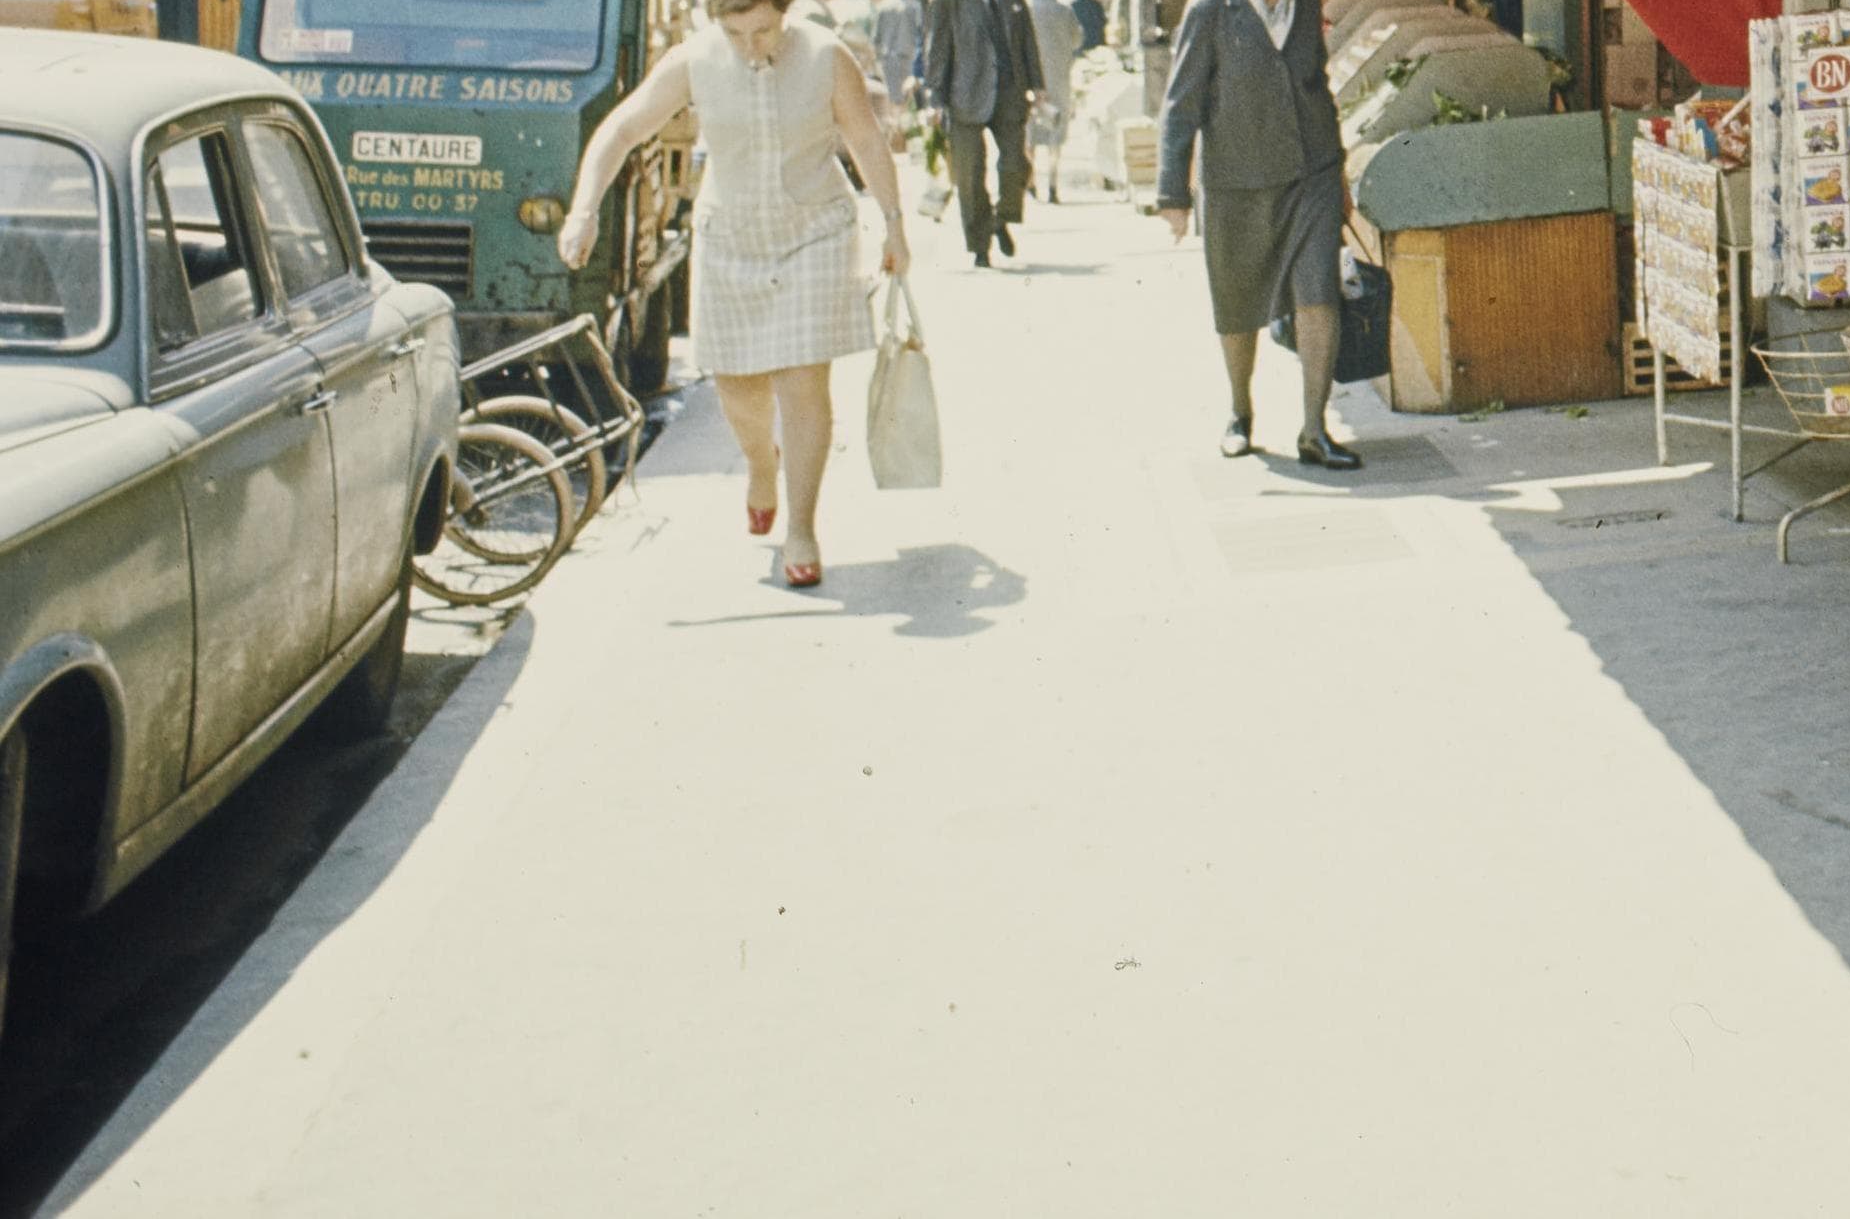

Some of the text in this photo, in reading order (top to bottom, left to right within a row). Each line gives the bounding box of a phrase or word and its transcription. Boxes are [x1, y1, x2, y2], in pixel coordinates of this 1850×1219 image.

[1816, 59, 1847, 88] BN
[337, 72, 446, 101] QUATRE
[460, 76, 575, 104] SAISONS
[357, 136, 478, 161] CENTAURE
[347, 167, 379, 187] Rue
[412, 168, 505, 191] MARTYRS
